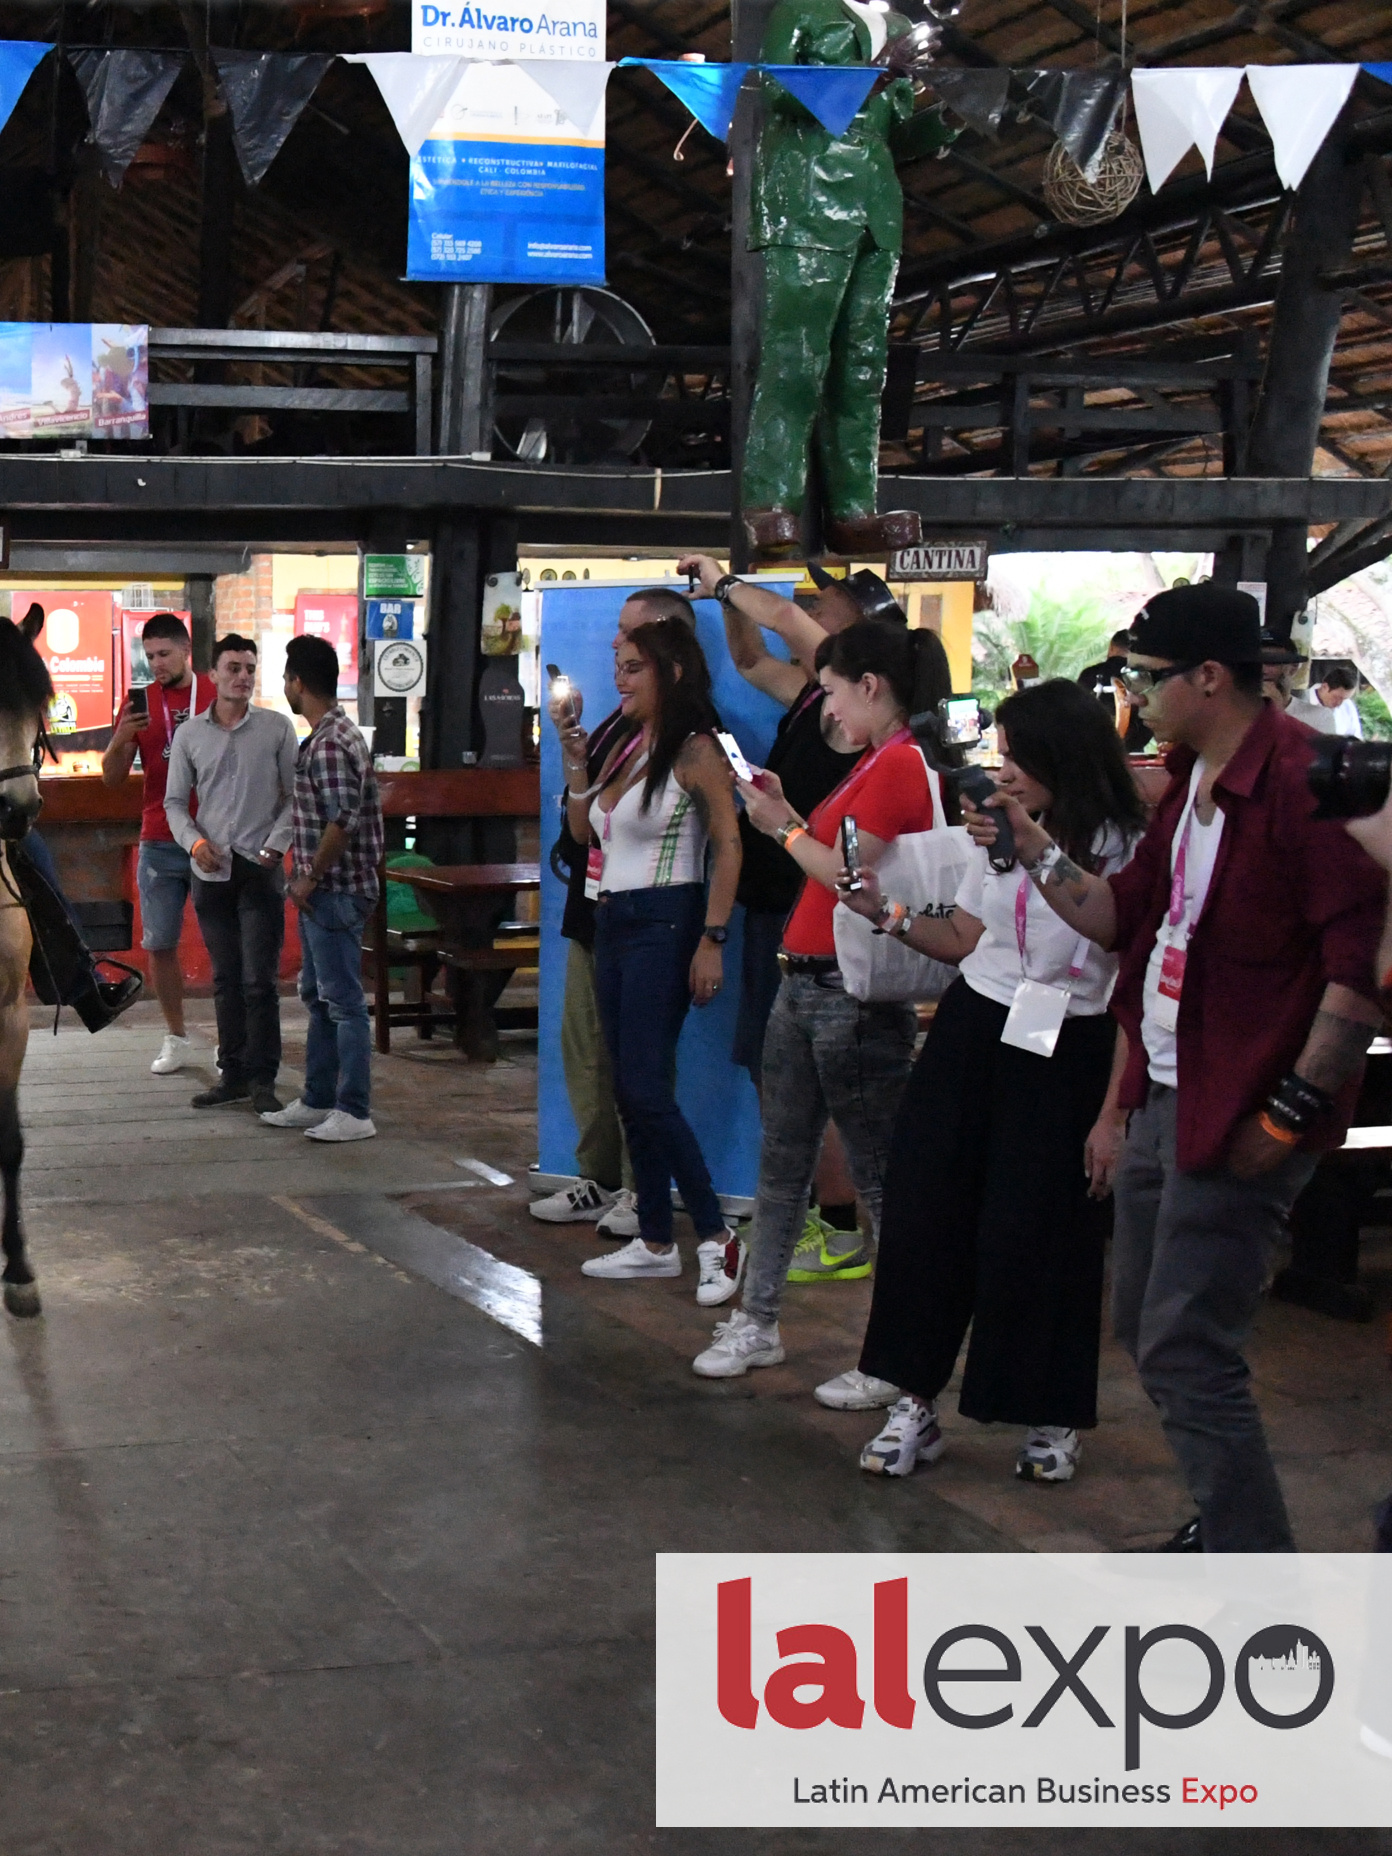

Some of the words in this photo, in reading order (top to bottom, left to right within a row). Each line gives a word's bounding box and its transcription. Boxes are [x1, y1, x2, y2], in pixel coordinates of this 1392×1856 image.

[421, 4, 455, 28] Dr.
[458, 1, 534, 34] Álvaro
[535, 13, 598, 39] Arana
[423, 36, 509, 52] CIRUJANO
[519, 41, 597, 58] PLÁSTICO
[478, 166, 498, 174] CALI
[504, 168, 546, 176] COLOMBIA
[36, 411, 88, 427] Villavicencio
[98, 412, 147, 428] Barranquilla
[898, 548, 977, 571] CANTINA
[380, 602, 402, 614] BAR
[50, 655, 105, 673] Colombia
